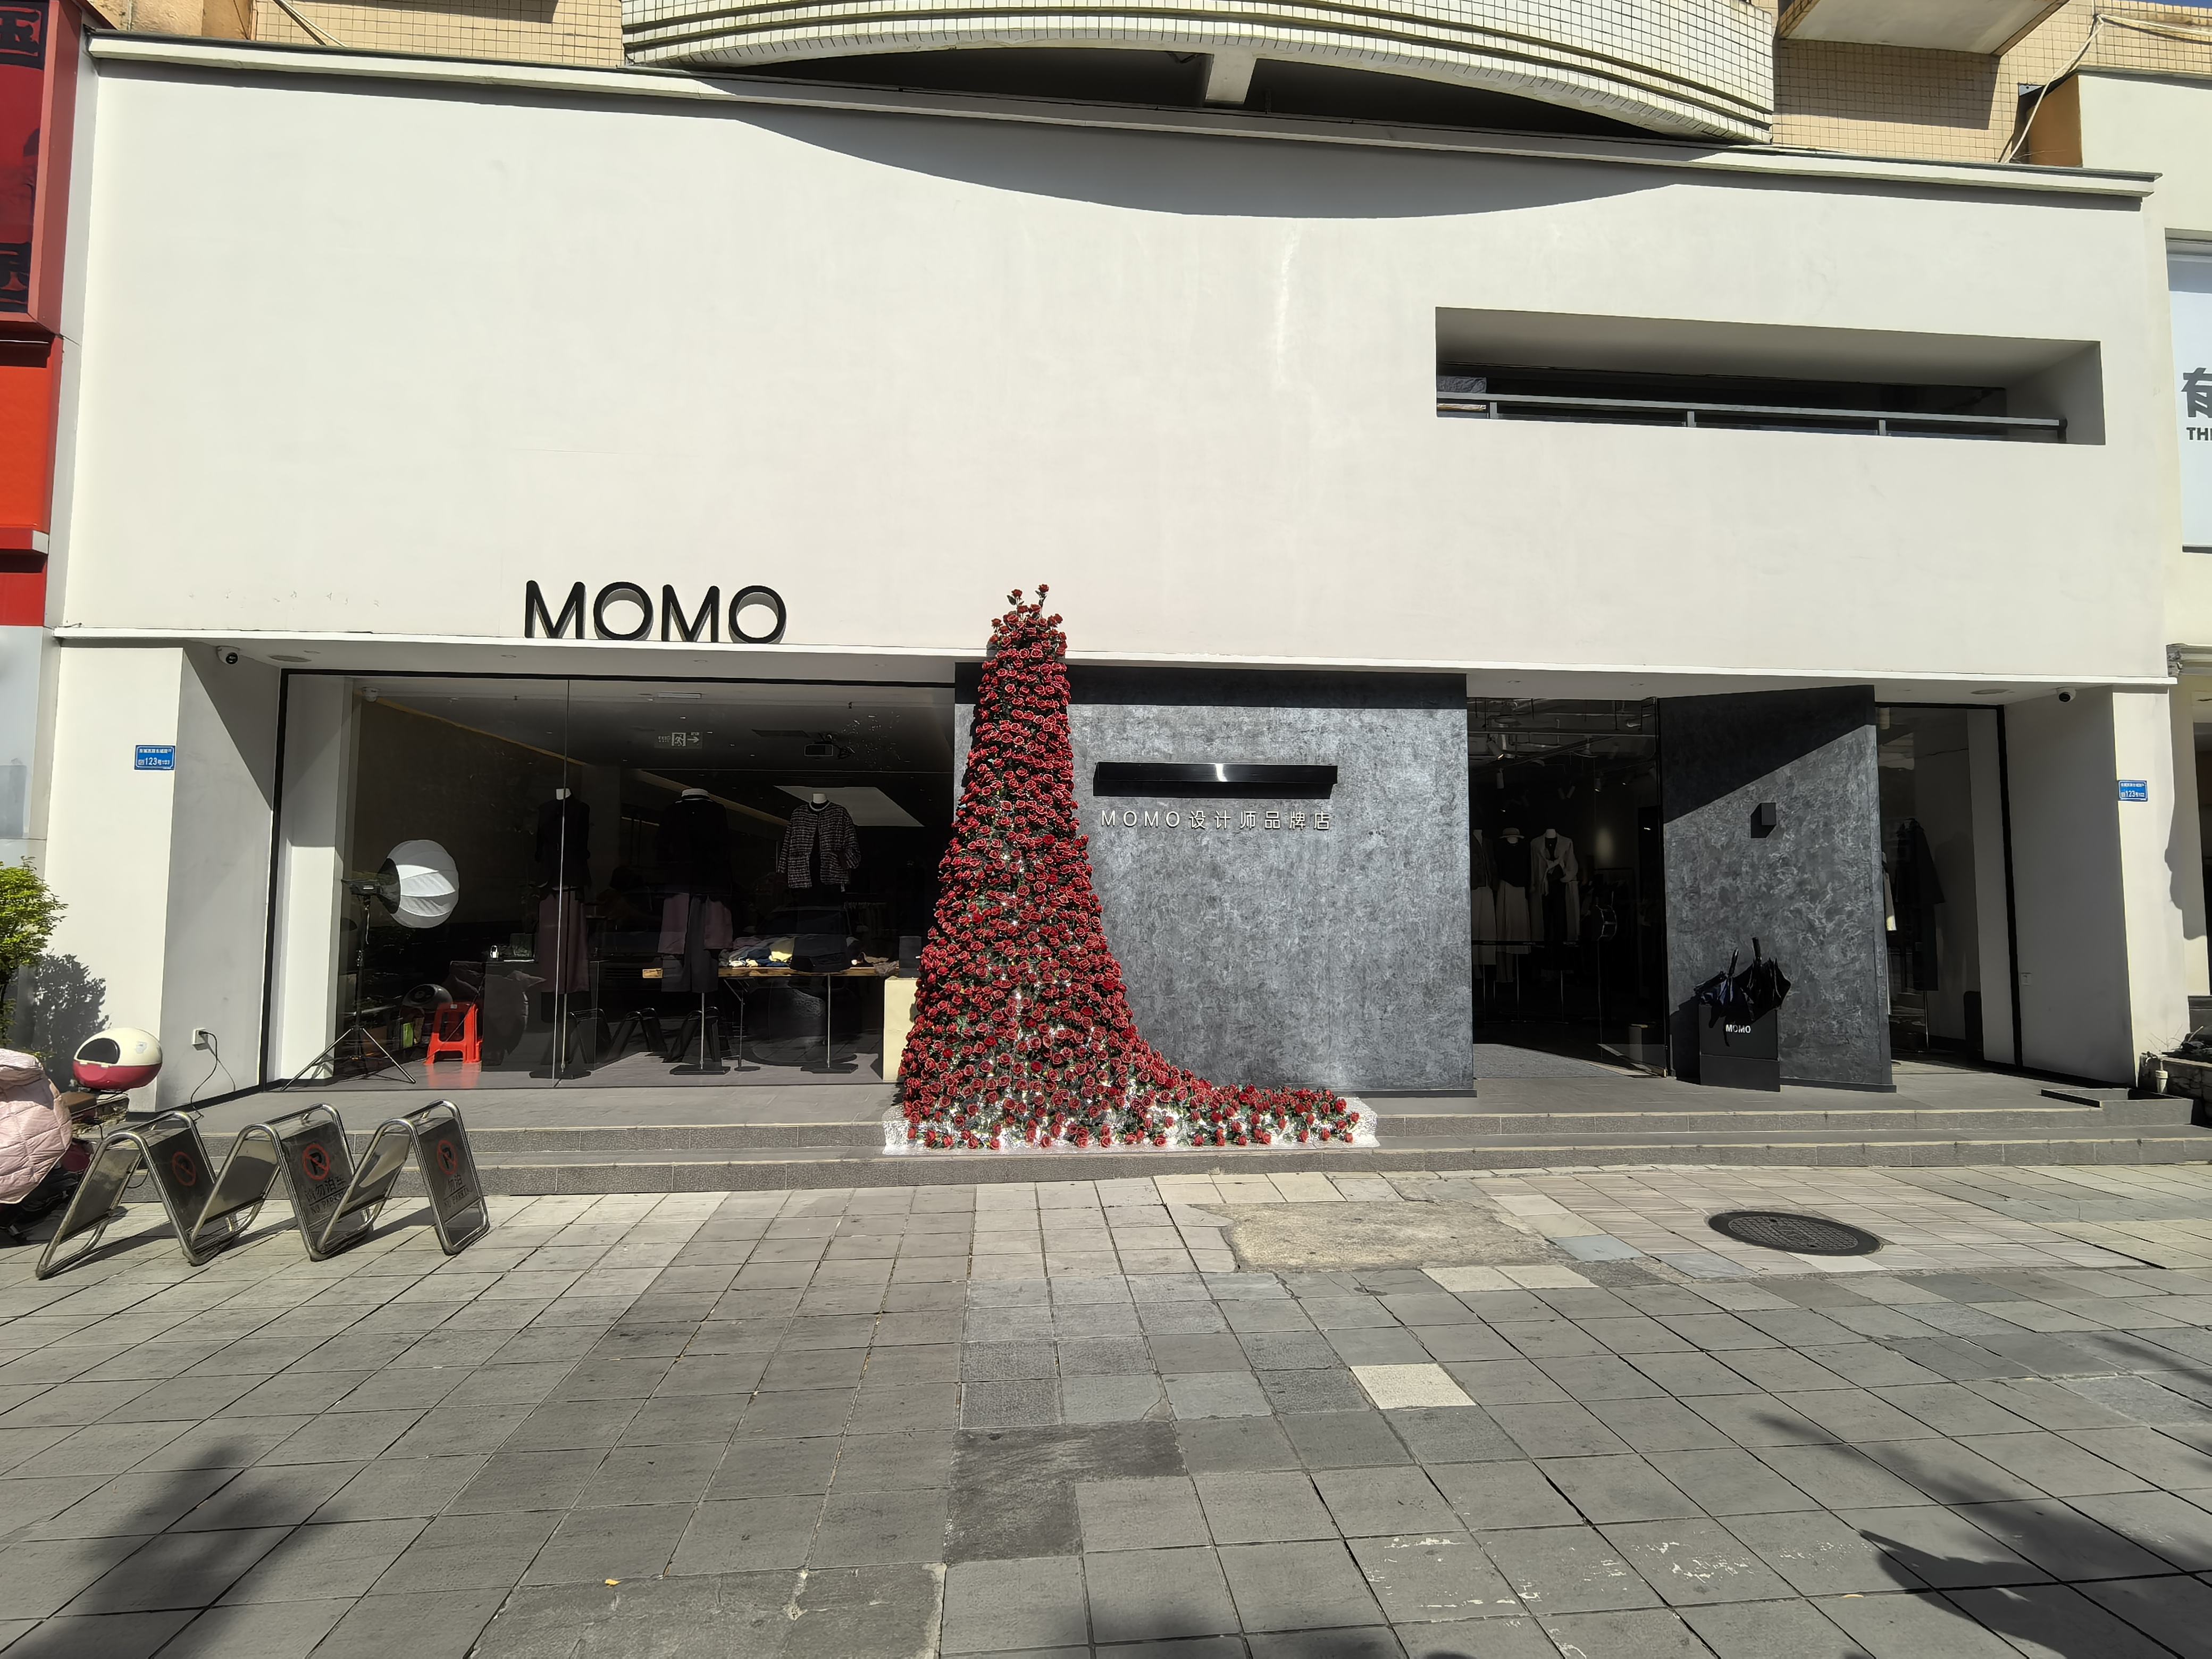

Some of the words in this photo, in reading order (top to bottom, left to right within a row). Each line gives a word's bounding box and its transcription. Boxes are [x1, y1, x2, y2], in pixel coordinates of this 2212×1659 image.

[2186, 427, 2212, 441] TH
[524, 580, 786, 643] MOMO
[1725, 1024, 1751, 1033] MOMO
